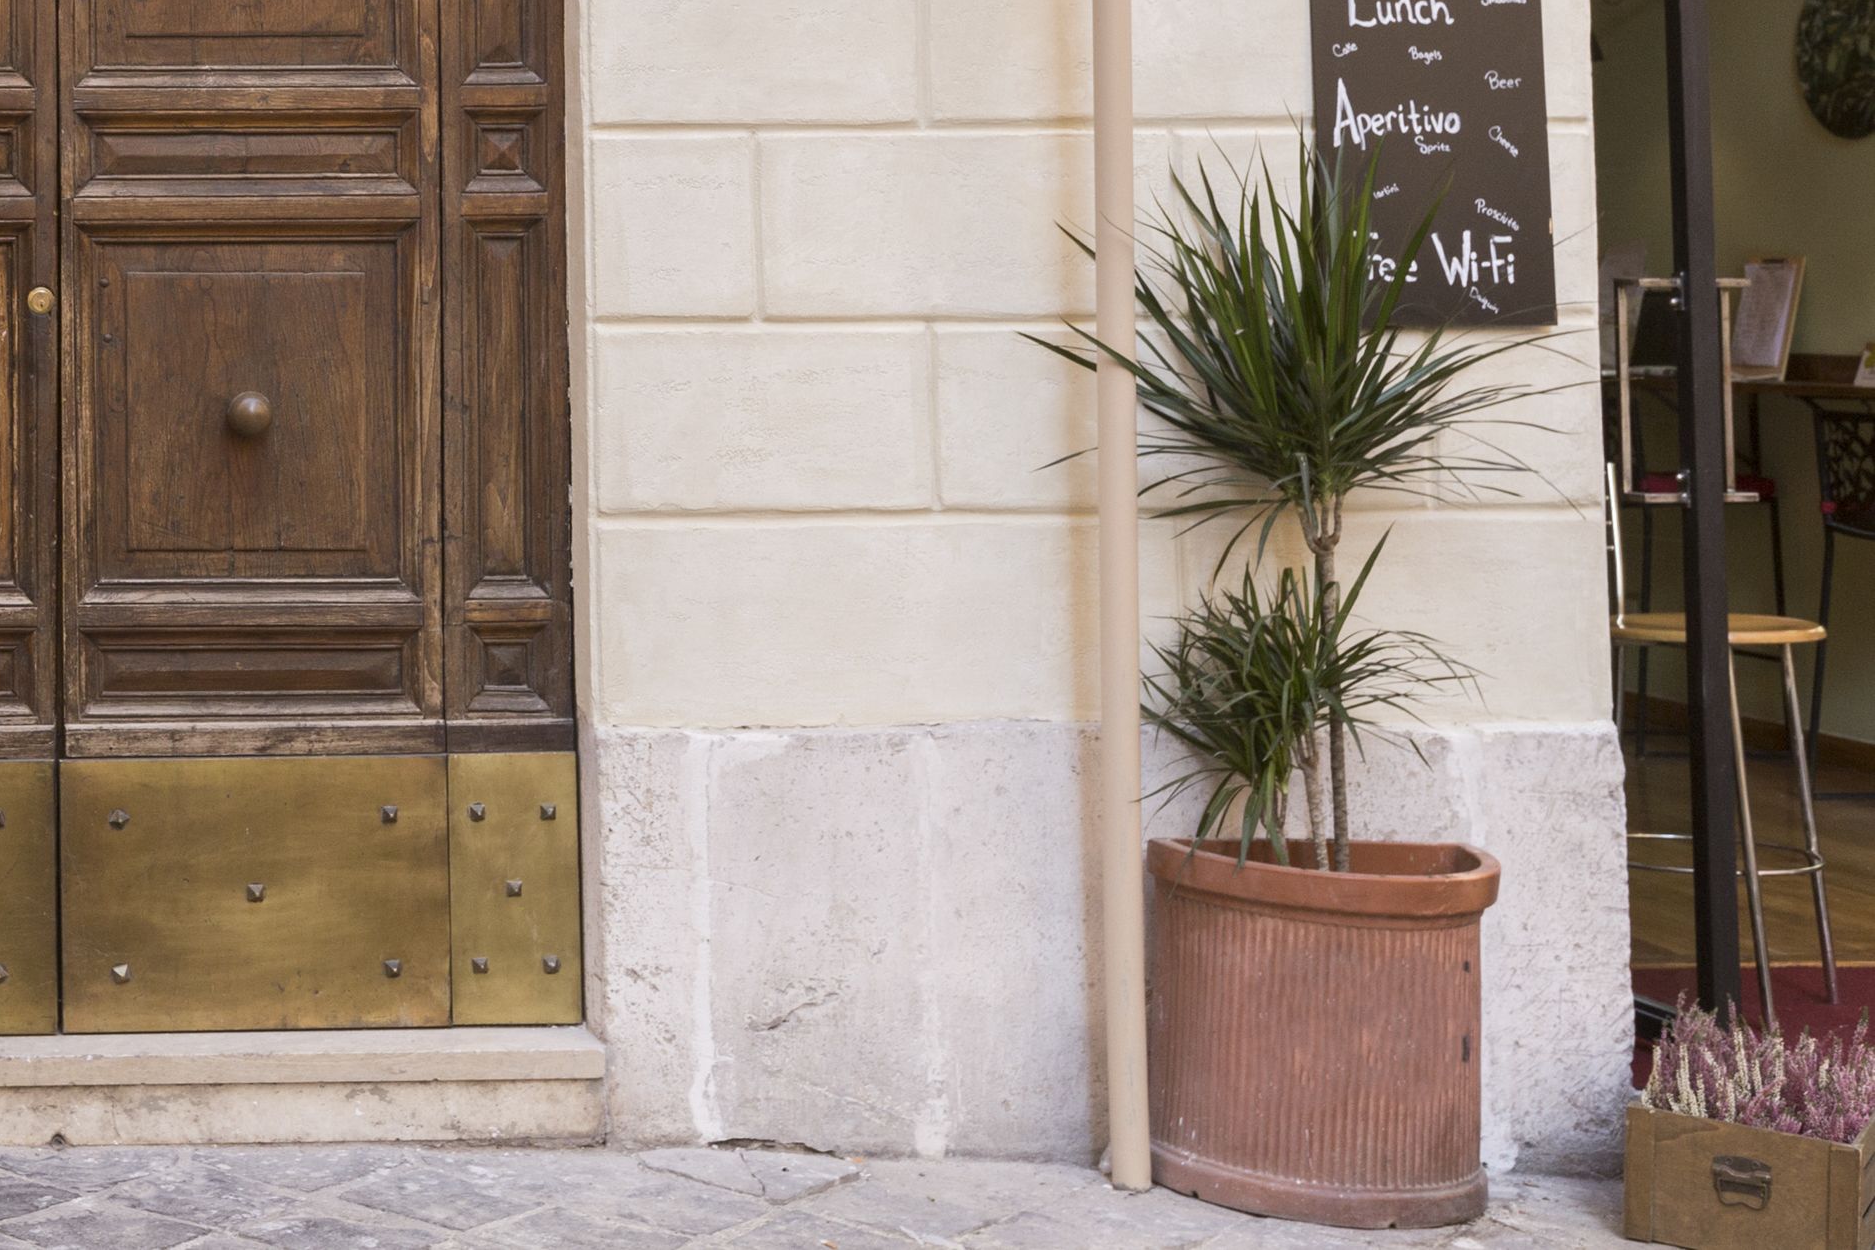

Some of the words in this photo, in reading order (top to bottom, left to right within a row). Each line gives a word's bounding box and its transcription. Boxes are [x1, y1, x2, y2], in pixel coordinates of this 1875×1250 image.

[1408, 45, 1443, 65] Bagels
[1484, 70, 1522, 90] Beer
[1333, 77, 1461, 150] Aperitivo
[1488, 125, 1519, 158] Cheese
[1373, 182, 1400, 199] artini
[1430, 230, 1515, 287] Wi-Fi
